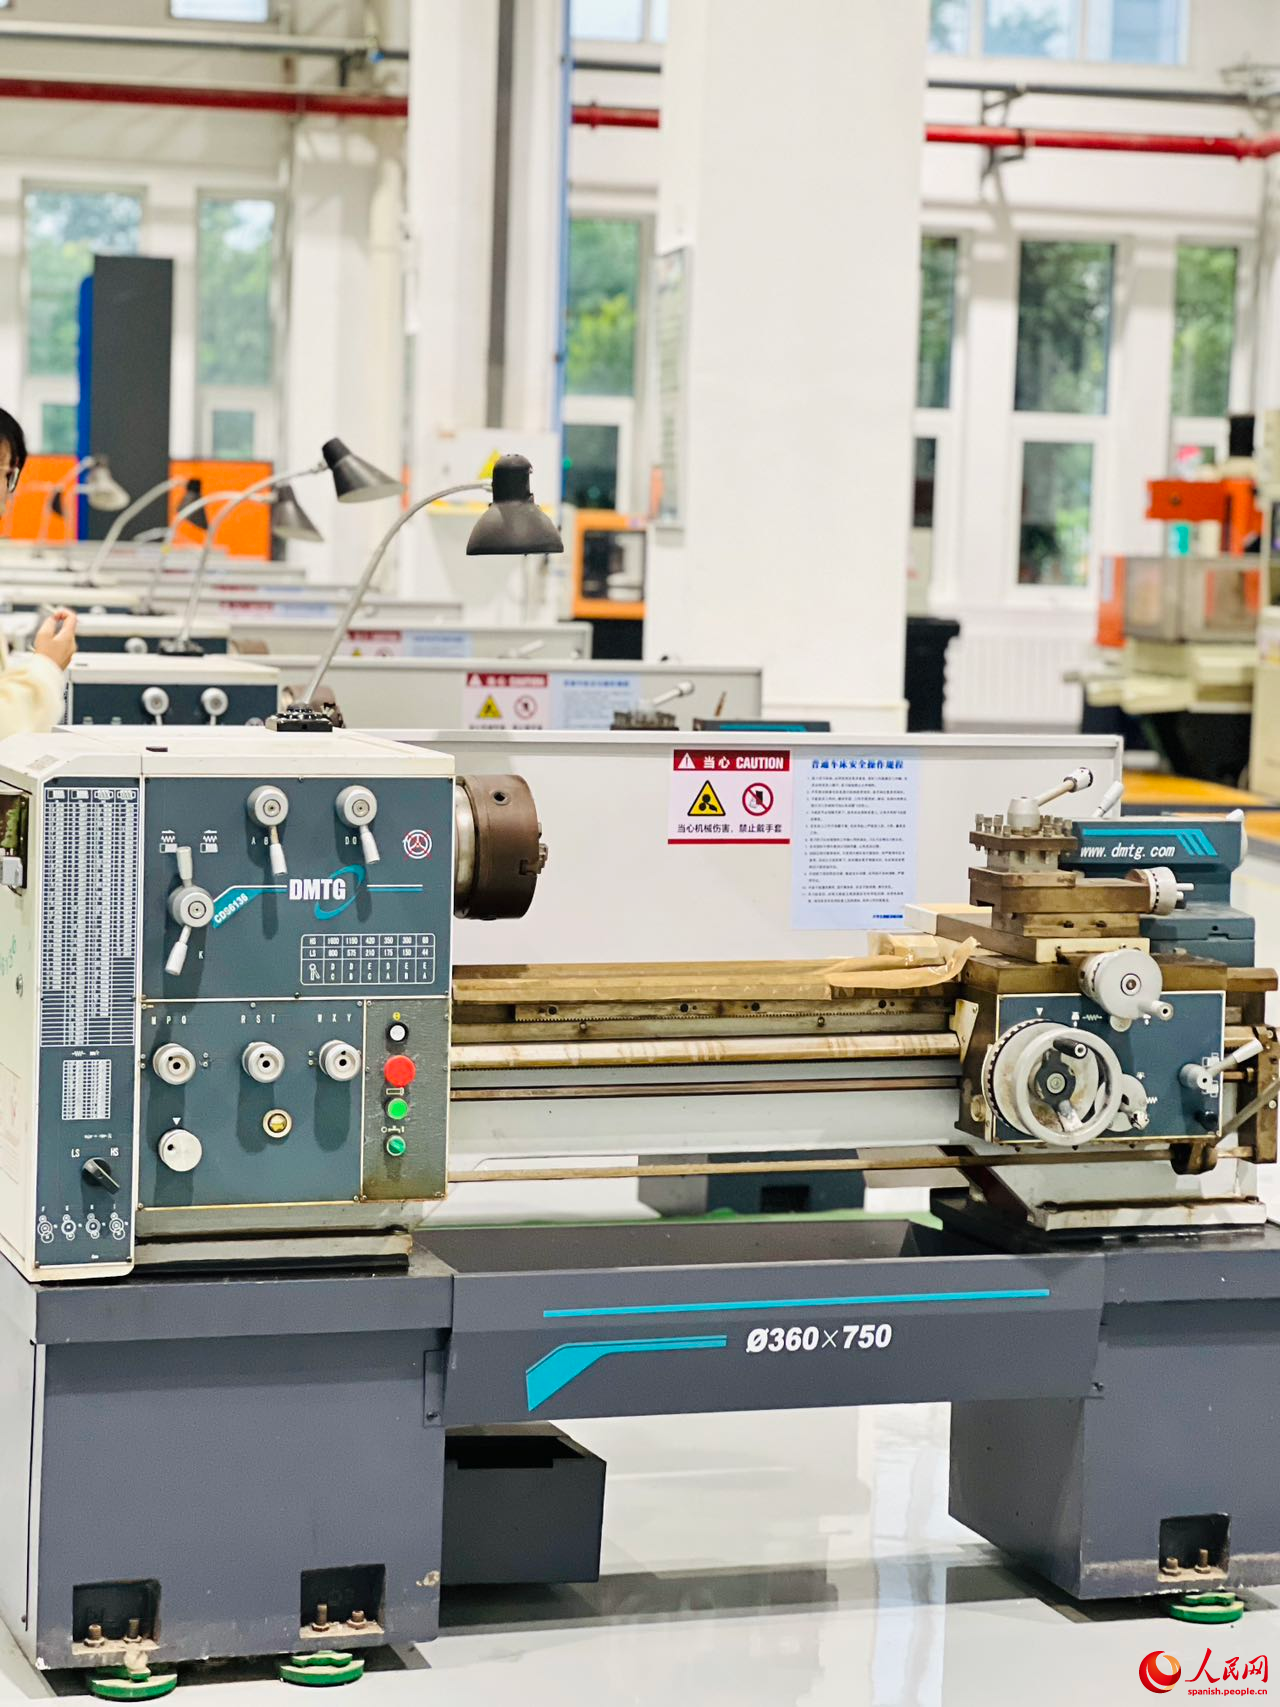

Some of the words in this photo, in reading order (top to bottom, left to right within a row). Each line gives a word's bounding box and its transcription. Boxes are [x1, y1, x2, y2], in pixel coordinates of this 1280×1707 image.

[703, 756, 730, 769] 当心
[736, 757, 784, 769] CAUTION
[289, 879, 346, 900] DMTG
[309, 949, 316, 957] LS
[71, 1148, 80, 1158] LS
[110, 1147, 119, 1157] HS
